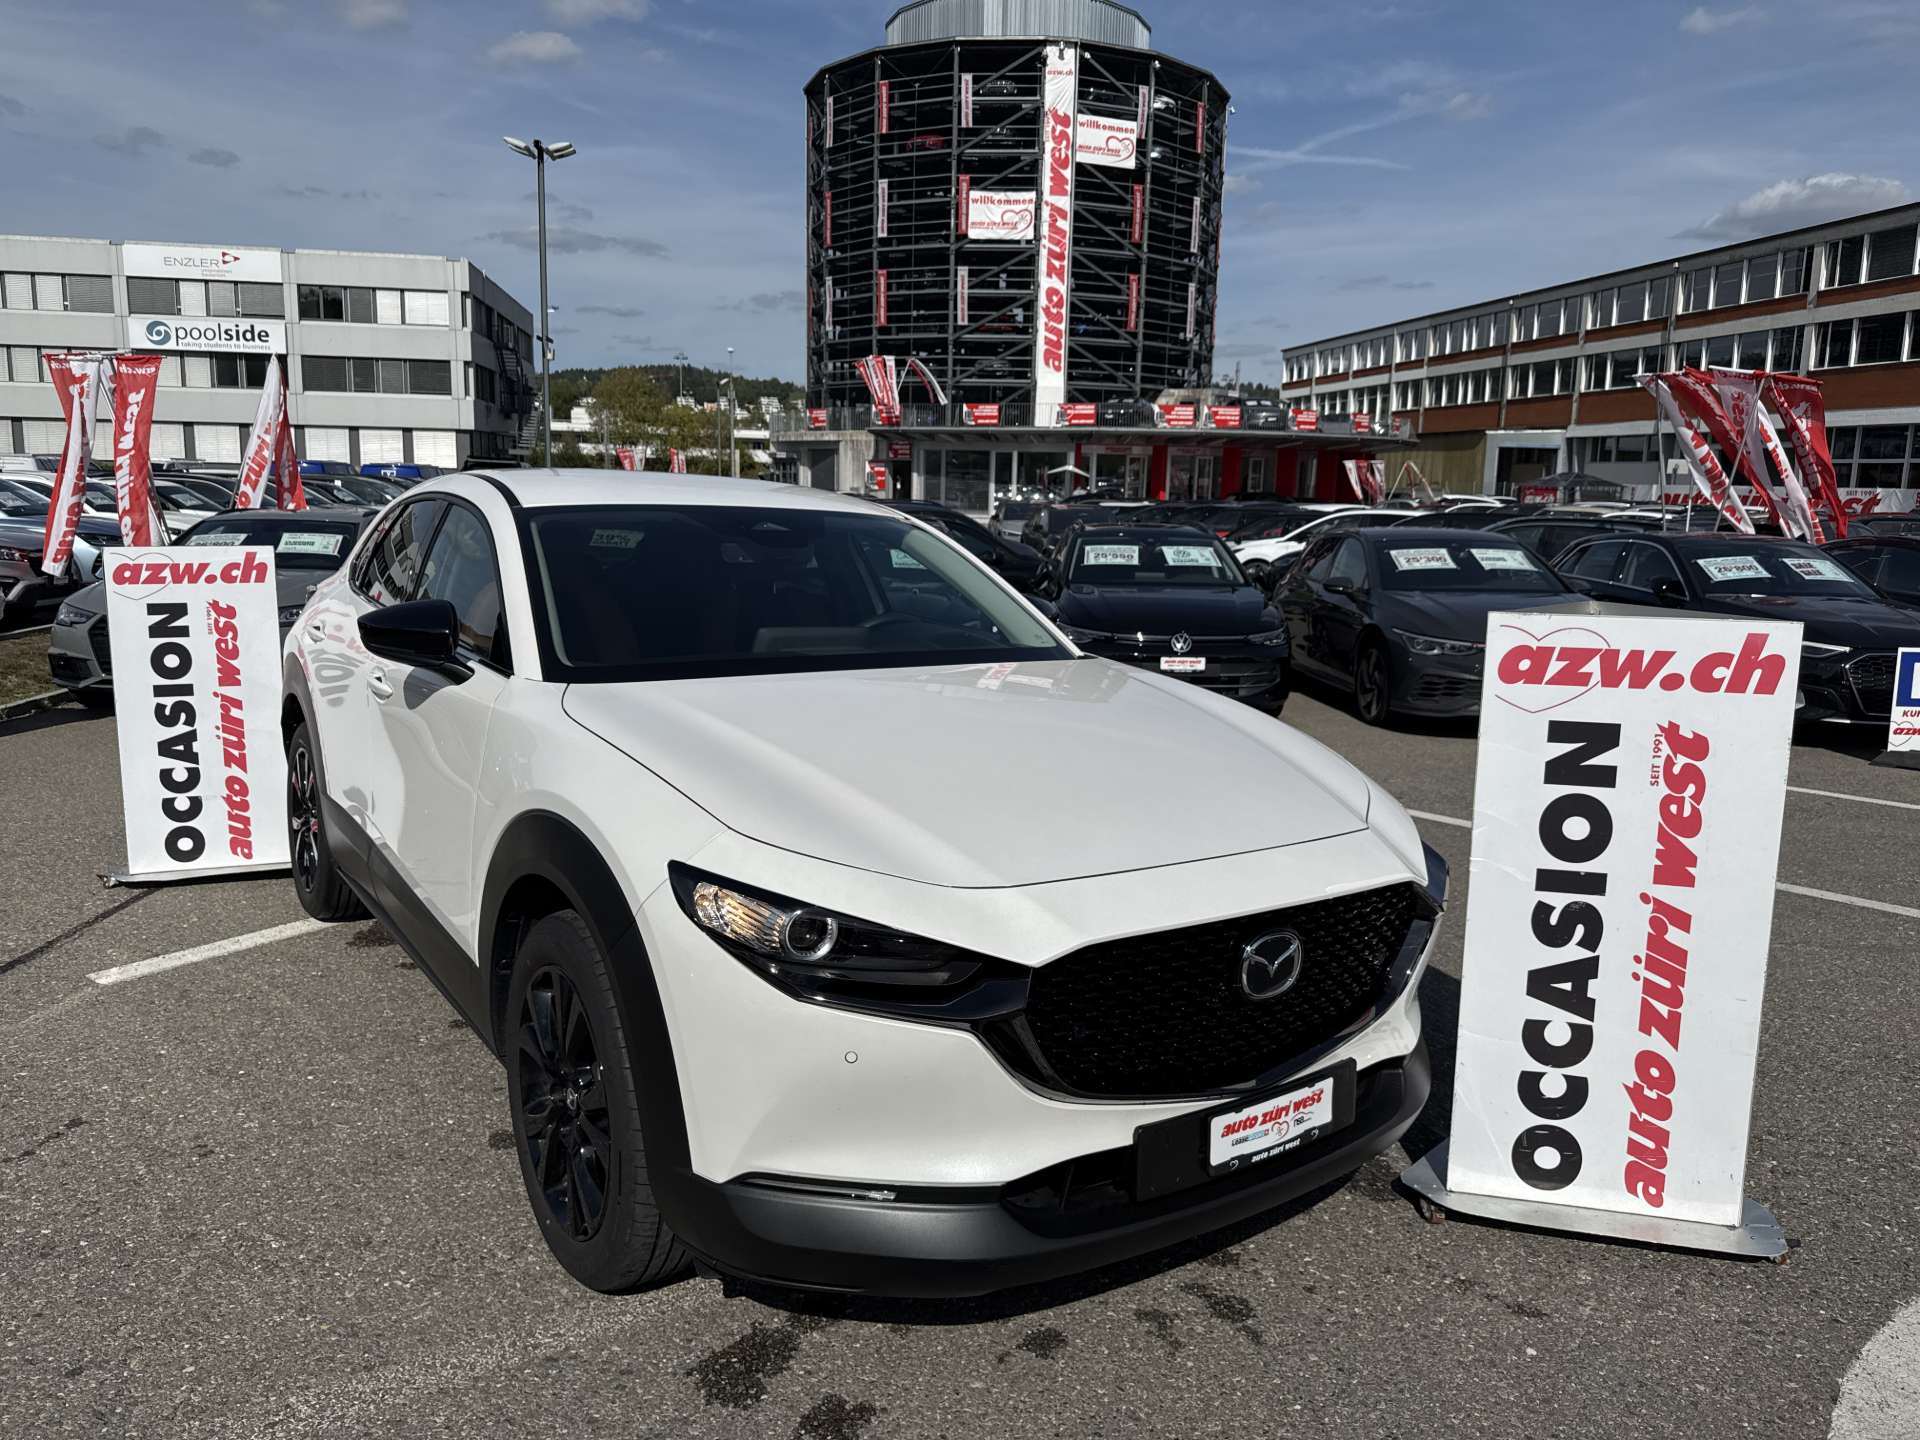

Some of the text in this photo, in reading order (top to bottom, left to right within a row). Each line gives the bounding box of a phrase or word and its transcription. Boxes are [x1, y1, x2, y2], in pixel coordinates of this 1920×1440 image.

[1078, 119, 1135, 135] willkommen
[971, 195, 1033, 206] willkommen
[163, 256, 220, 268] ENZLER
[1041, 107, 1072, 373] auto züri west
[175, 322, 269, 347] poolside
[112, 551, 269, 586] azw.ch
[1497, 632, 1787, 696] azw.ch
[147, 602, 206, 863] OCCASION
[207, 599, 254, 860] auto züri west
[1650, 733, 1664, 787] SEIT 1991
[1511, 719, 1622, 1191] OCCASION
[1622, 720, 1710, 1208] auto züri west
[1221, 1088, 1324, 1138] auto züri west
[1251, 1152, 1268, 1163] auto
[1285, 1138, 1301, 1150] west
